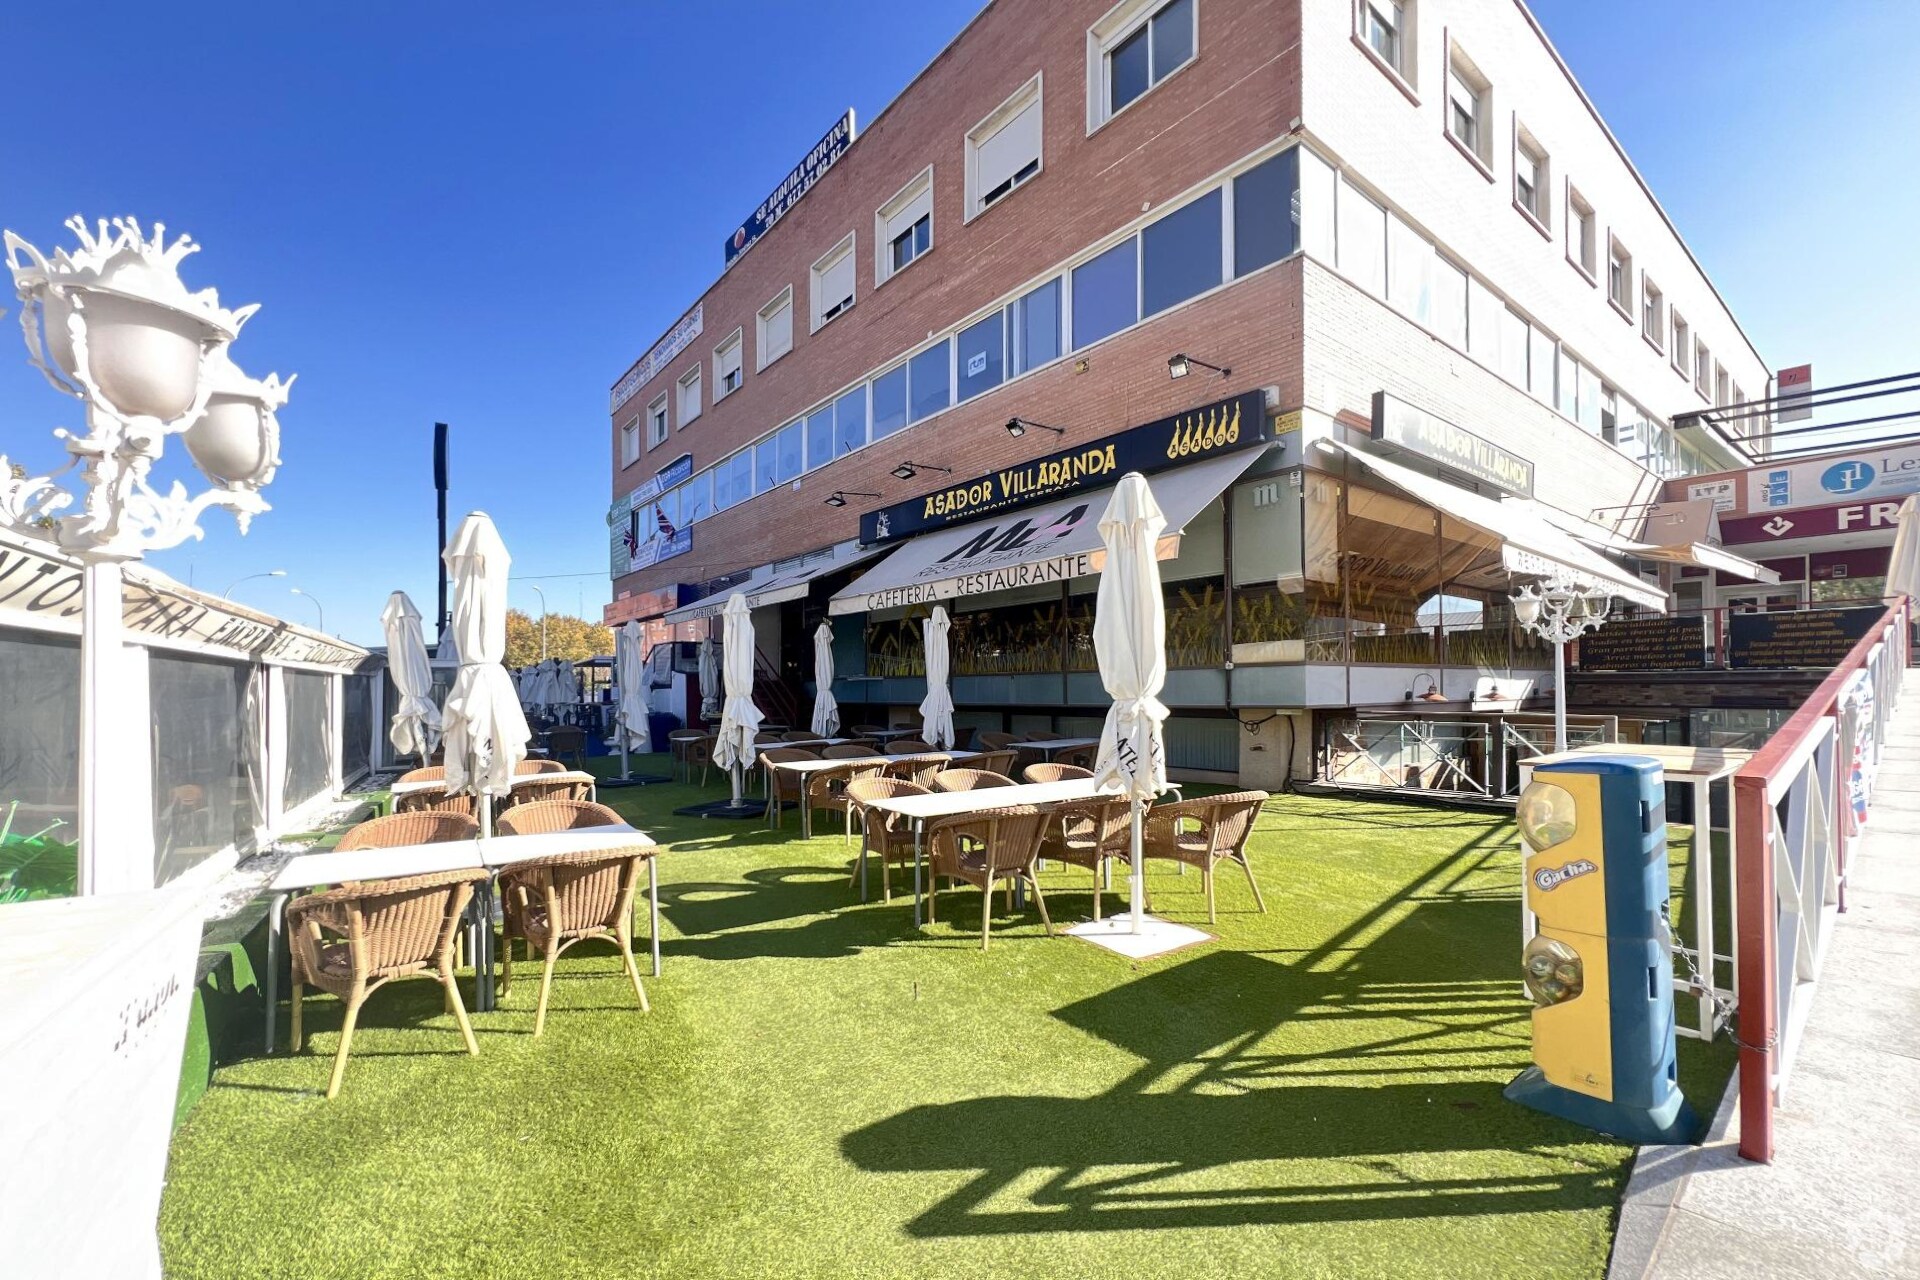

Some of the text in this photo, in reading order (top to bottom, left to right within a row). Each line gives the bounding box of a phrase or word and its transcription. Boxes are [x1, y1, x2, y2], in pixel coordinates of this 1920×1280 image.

[767, 163, 806, 213] ALQUILA
[806, 116, 850, 170] OFICINA
[1170, 430, 1236, 456] ASADOR
[1418, 416, 1472, 460] ASADOR
[923, 444, 1117, 520] ASADOR VILLARANDA
[1880, 457, 1920, 474] Le
[945, 480, 1081, 521] RESTAURANTE TERRAZA
[913, 538, 1062, 579] RESTAURANTE
[866, 583, 937, 611] CAFETERIA
[956, 554, 1088, 596] RESTAURANTE
[692, 605, 719, 620] CAFETERIA
